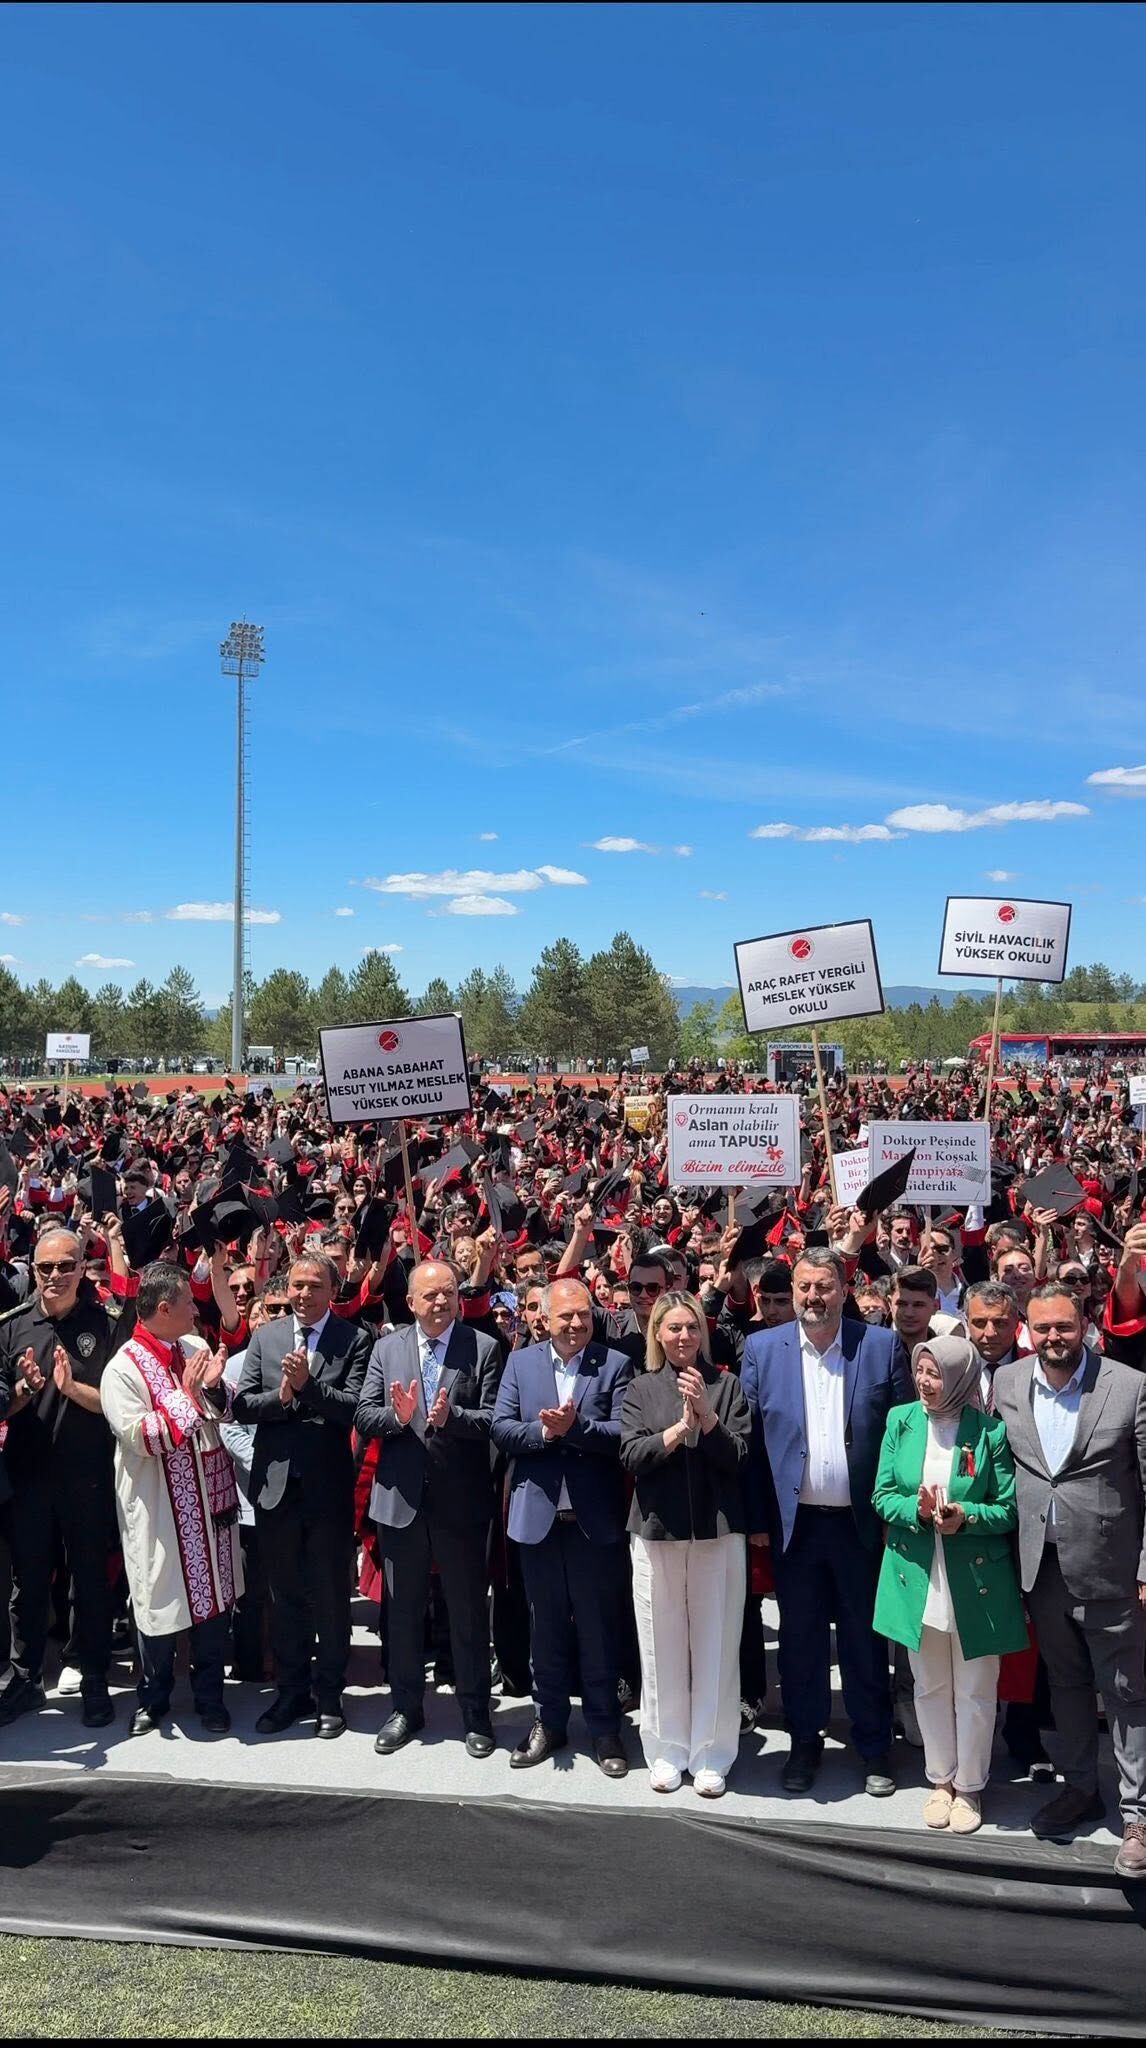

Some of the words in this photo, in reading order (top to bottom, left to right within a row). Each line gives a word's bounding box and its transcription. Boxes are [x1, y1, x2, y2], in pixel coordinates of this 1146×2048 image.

[954, 930, 985, 943] SİVİL
[988, 934, 1055, 949] HAVACILIK
[956, 946, 1004, 960] YÜKSEK
[1008, 951, 1051, 964] OKULU
[748, 978, 776, 992] ARAÇ
[780, 971, 816, 987] RAFET
[818, 961, 866, 980] VERGİLİ
[762, 988, 806, 1005] MESLEK
[808, 980, 856, 996] YÜKSEK
[789, 1000, 828, 1016] OKULU
[343, 1066, 384, 1080] ABANA
[387, 1060, 444, 1076] SABAHAT
[329, 1084, 366, 1096] MESUT
[369, 1080, 414, 1092] YILMAZ
[417, 1072, 465, 1088] MESLEK
[352, 1096, 399, 1110] YÜKSEK
[402, 1092, 443, 1106] OKULU
[688, 1104, 745, 1115] Ormanın
[748, 1103, 778, 1114] kralı
[688, 1119, 728, 1131] Aslan
[732, 1119, 780, 1131] olabilir
[688, 1139, 716, 1148] ama
[719, 1135, 778, 1147] TAPUSU
[883, 1135, 927, 1146] Doktor
[929, 1136, 976, 1148] Peşinde
[936, 1151, 978, 1163] Koşsak
[681, 1160, 724, 1172] Bizim
[728, 1160, 784, 1173] elimizde
